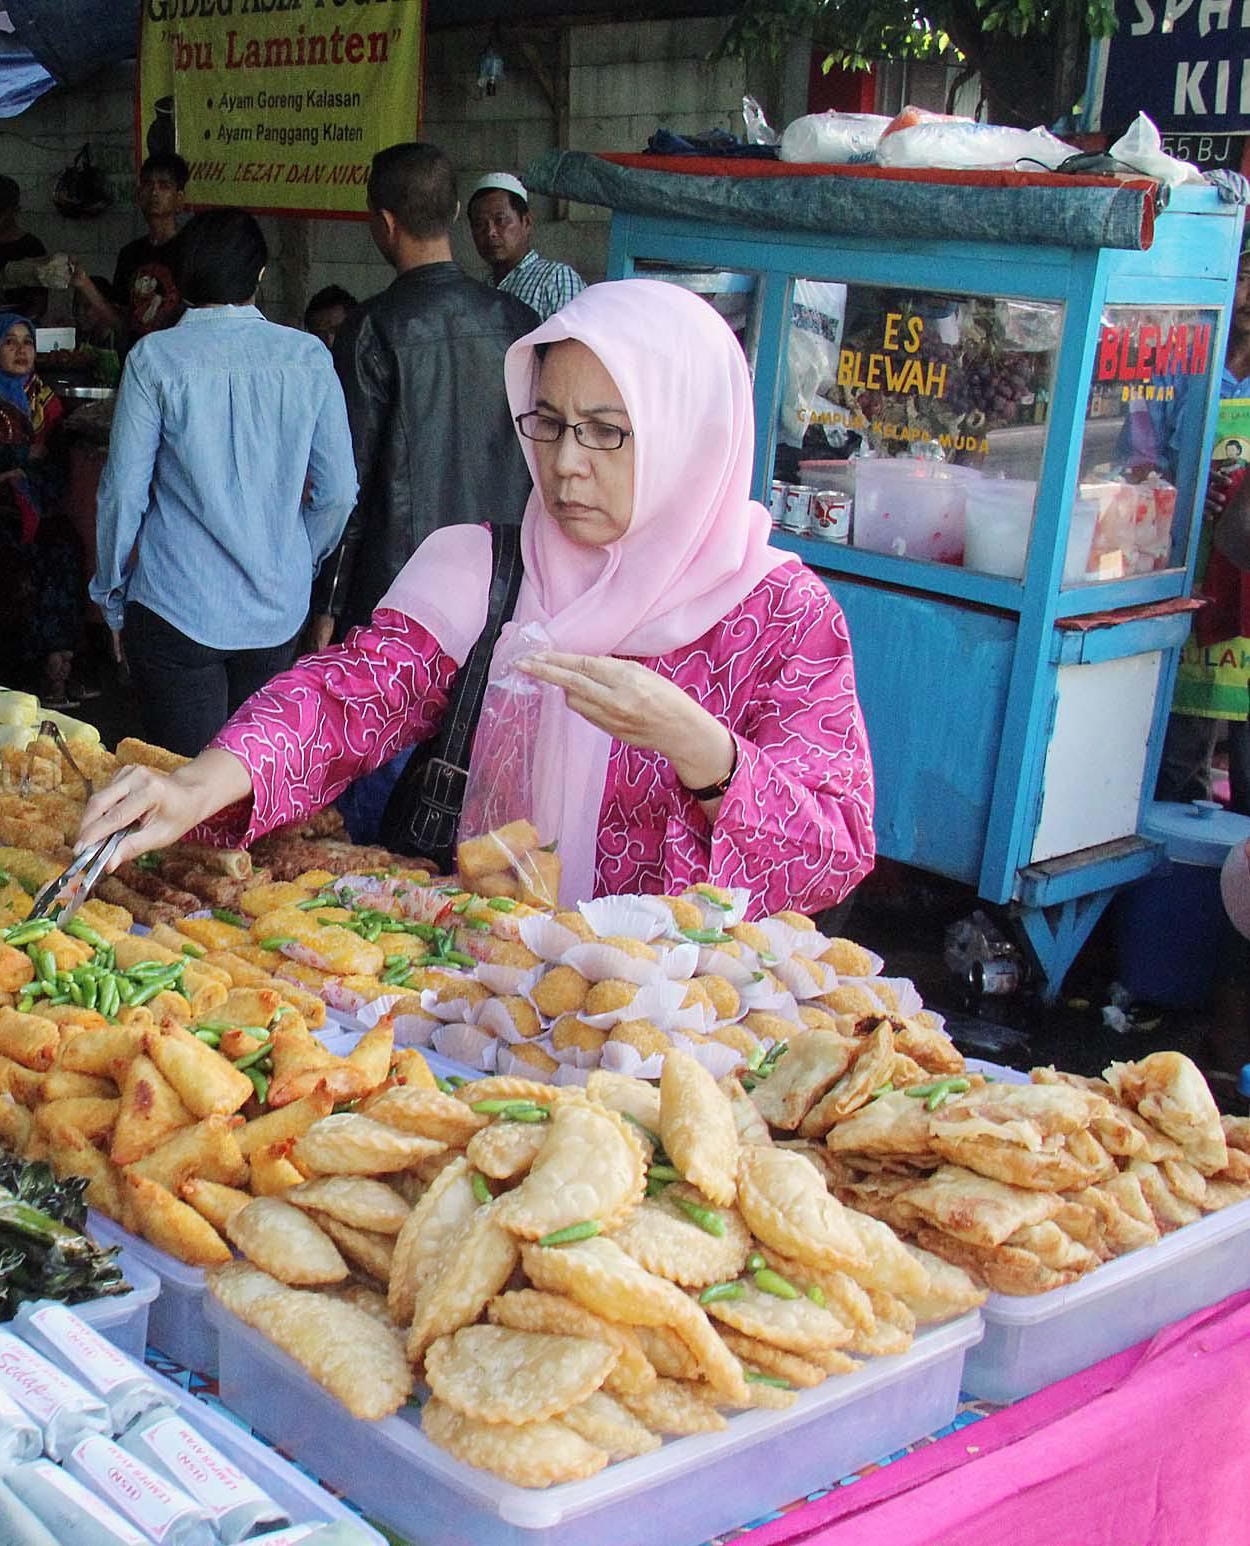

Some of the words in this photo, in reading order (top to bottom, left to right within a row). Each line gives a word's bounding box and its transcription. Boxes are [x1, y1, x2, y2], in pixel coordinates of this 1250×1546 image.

[1131, 0, 1250, 38] SPA
[219, 92, 254, 112] Ayam
[257, 90, 302, 112] Goreng
[306, 89, 360, 109] Kalasan
[217, 123, 252, 144] Ayam
[256, 124, 319, 146] Panggang
[323, 123, 363, 142] Klaten
[234, 163, 285, 184] LEZAT
[286, 164, 324, 184] DAN
[883, 313, 924, 354] ES
[1098, 324, 1211, 381] BLEWAH
[837, 349, 947, 398] BLEWAH
[798, 408, 863, 430] CAMPUR
[939, 433, 990, 454] MUDA
